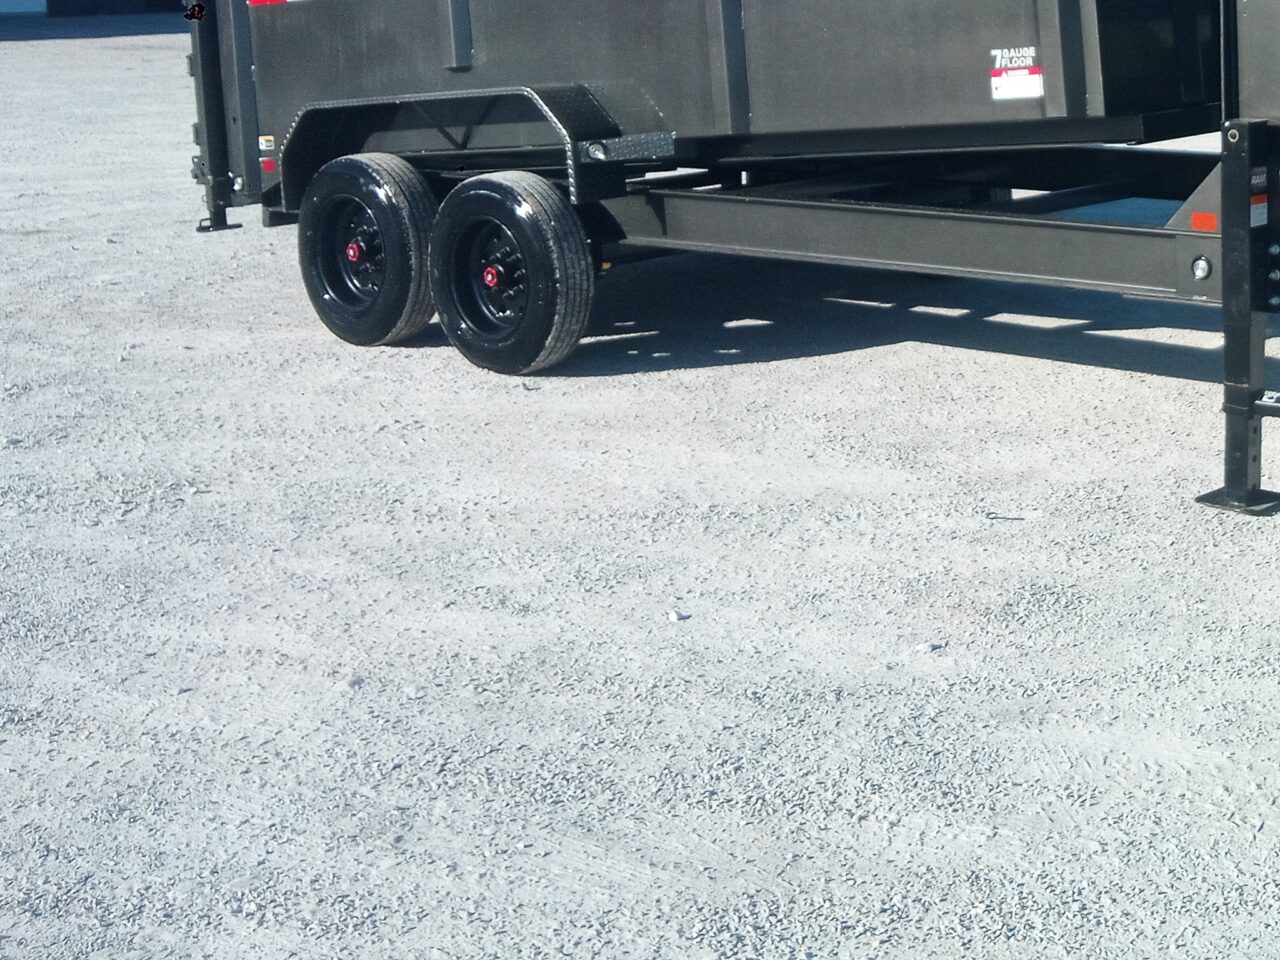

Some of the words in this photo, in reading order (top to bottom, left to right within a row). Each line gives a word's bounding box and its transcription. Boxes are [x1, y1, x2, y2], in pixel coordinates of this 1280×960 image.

[990, 48, 1002, 69] 7
[1002, 46, 1036, 58] GAUGE
[1001, 56, 1034, 68] FLOOR
